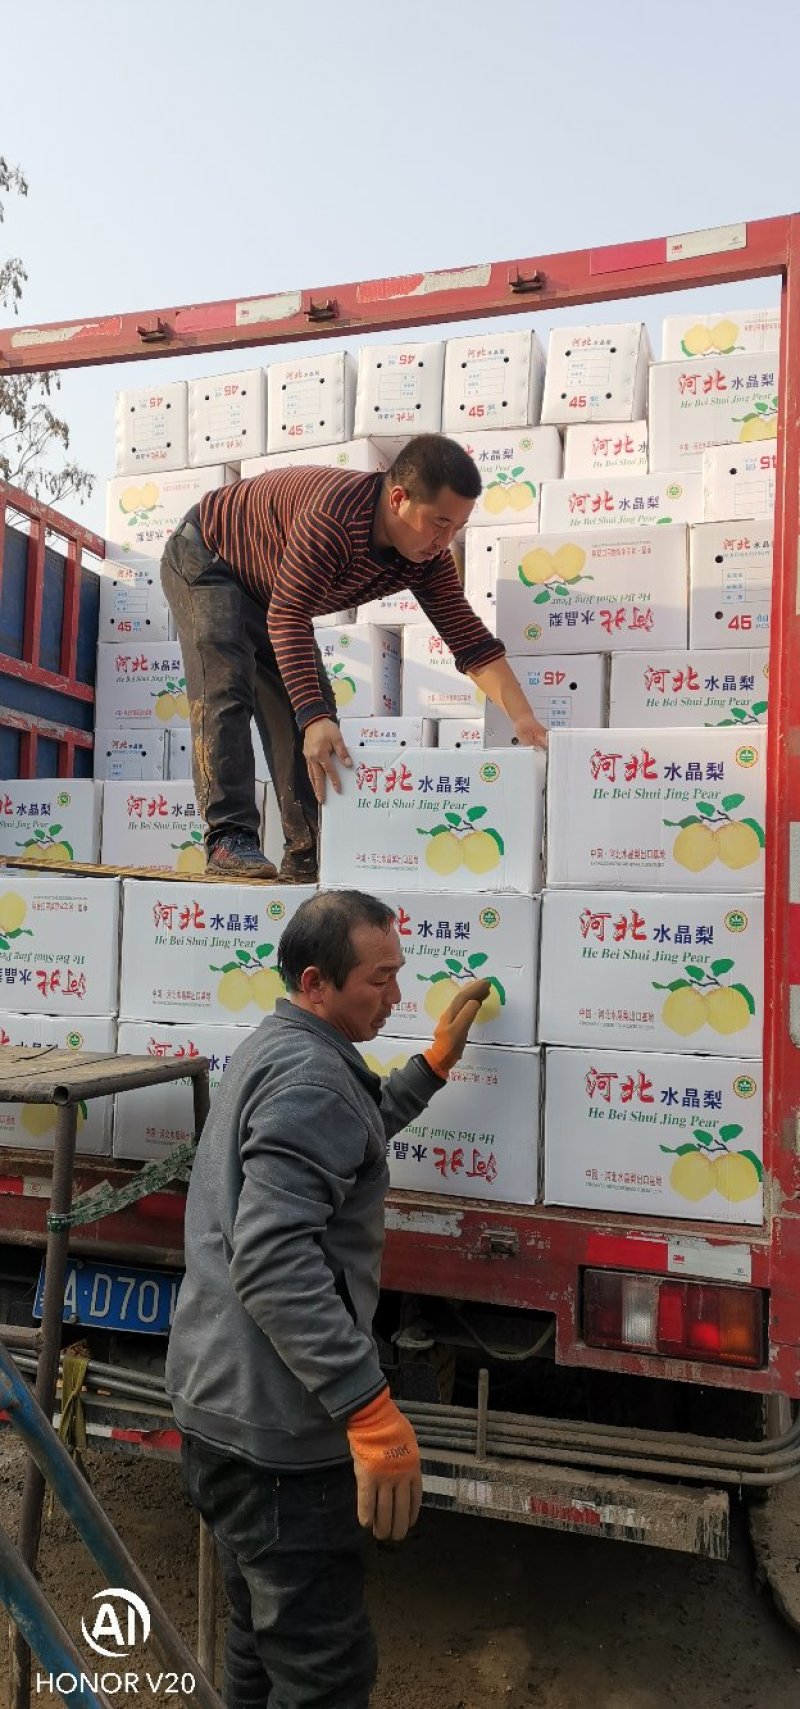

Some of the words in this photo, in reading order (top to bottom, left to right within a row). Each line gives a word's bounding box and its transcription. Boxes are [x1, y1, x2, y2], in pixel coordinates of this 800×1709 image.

[569, 396, 587, 408] 45
[469, 405, 485, 417] 45
[288, 425, 304, 436] 45
[118, 621, 132, 632] 45
[728, 614, 752, 630] 45
[544, 671, 566, 685] 45
[593, 787, 609, 799] He
[612, 787, 631, 799] Bei
[633, 787, 660, 799] Shui
[664, 787, 690, 801] Jing
[693, 787, 721, 799] Pear
[357, 799, 370, 808] He
[373, 799, 390, 808] Bei
[392, 799, 414, 809] Shui
[416, 799, 440, 812] Jing
[442, 800, 467, 810] Pear
[155, 935, 167, 945] He
[169, 936, 184, 946] Bei
[186, 936, 208, 947] Shui
[209, 937, 231, 948] Jing
[233, 938, 256, 948] Pear
[416, 944, 440, 958] Jing
[443, 945, 468, 957] Pear
[582, 947, 598, 958] He
[601, 948, 620, 959] Bei
[622, 949, 649, 960] Shui
[652, 950, 679, 964] Jing
[682, 952, 711, 964] Pear
[588, 1107, 604, 1118] He
[608, 1109, 627, 1120] Bei
[630, 1110, 657, 1123] Shui
[659, 1112, 687, 1128] Jing
[691, 1115, 719, 1128] Pear
